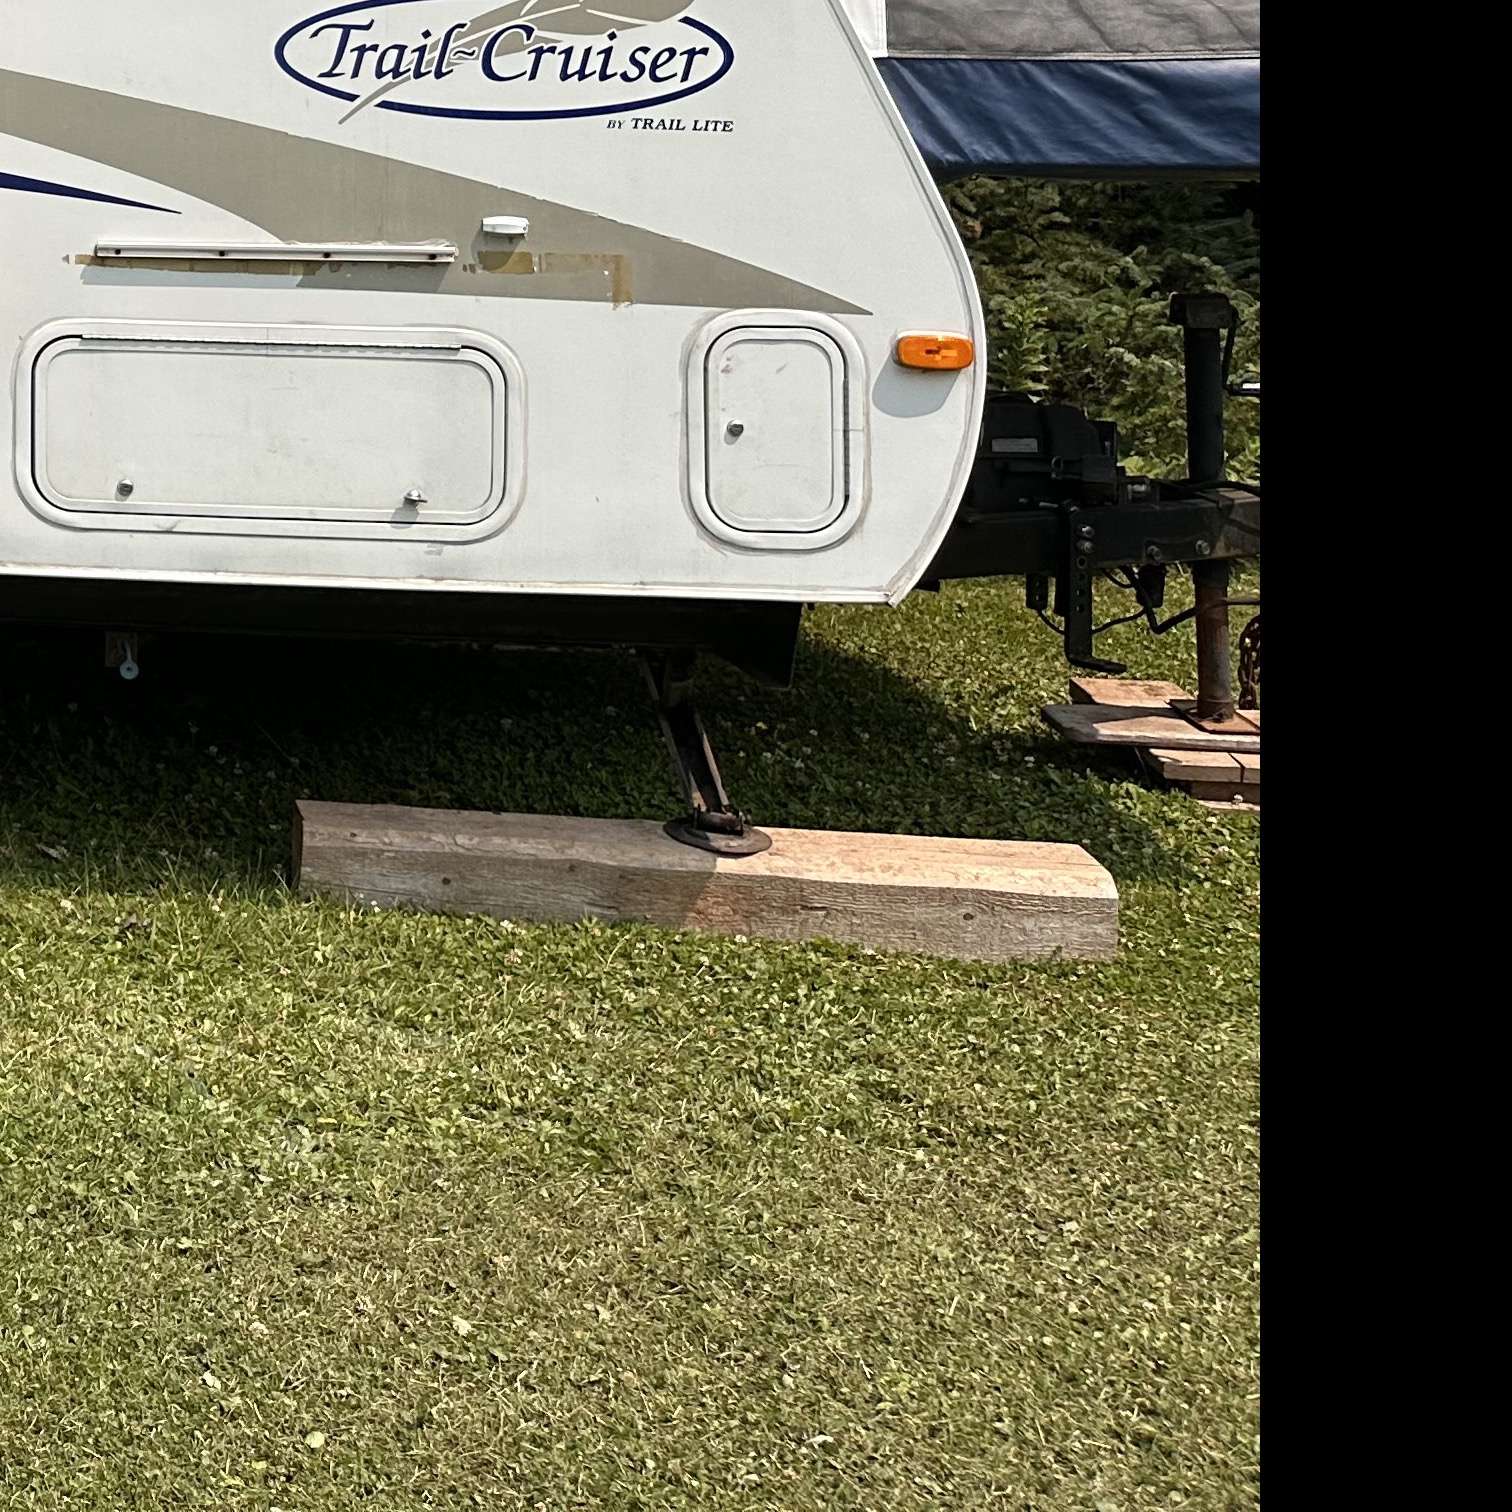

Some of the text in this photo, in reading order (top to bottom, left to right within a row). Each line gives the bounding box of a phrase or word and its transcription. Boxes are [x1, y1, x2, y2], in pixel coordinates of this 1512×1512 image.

[606, 117, 734, 132] BY TRAIL LITE
